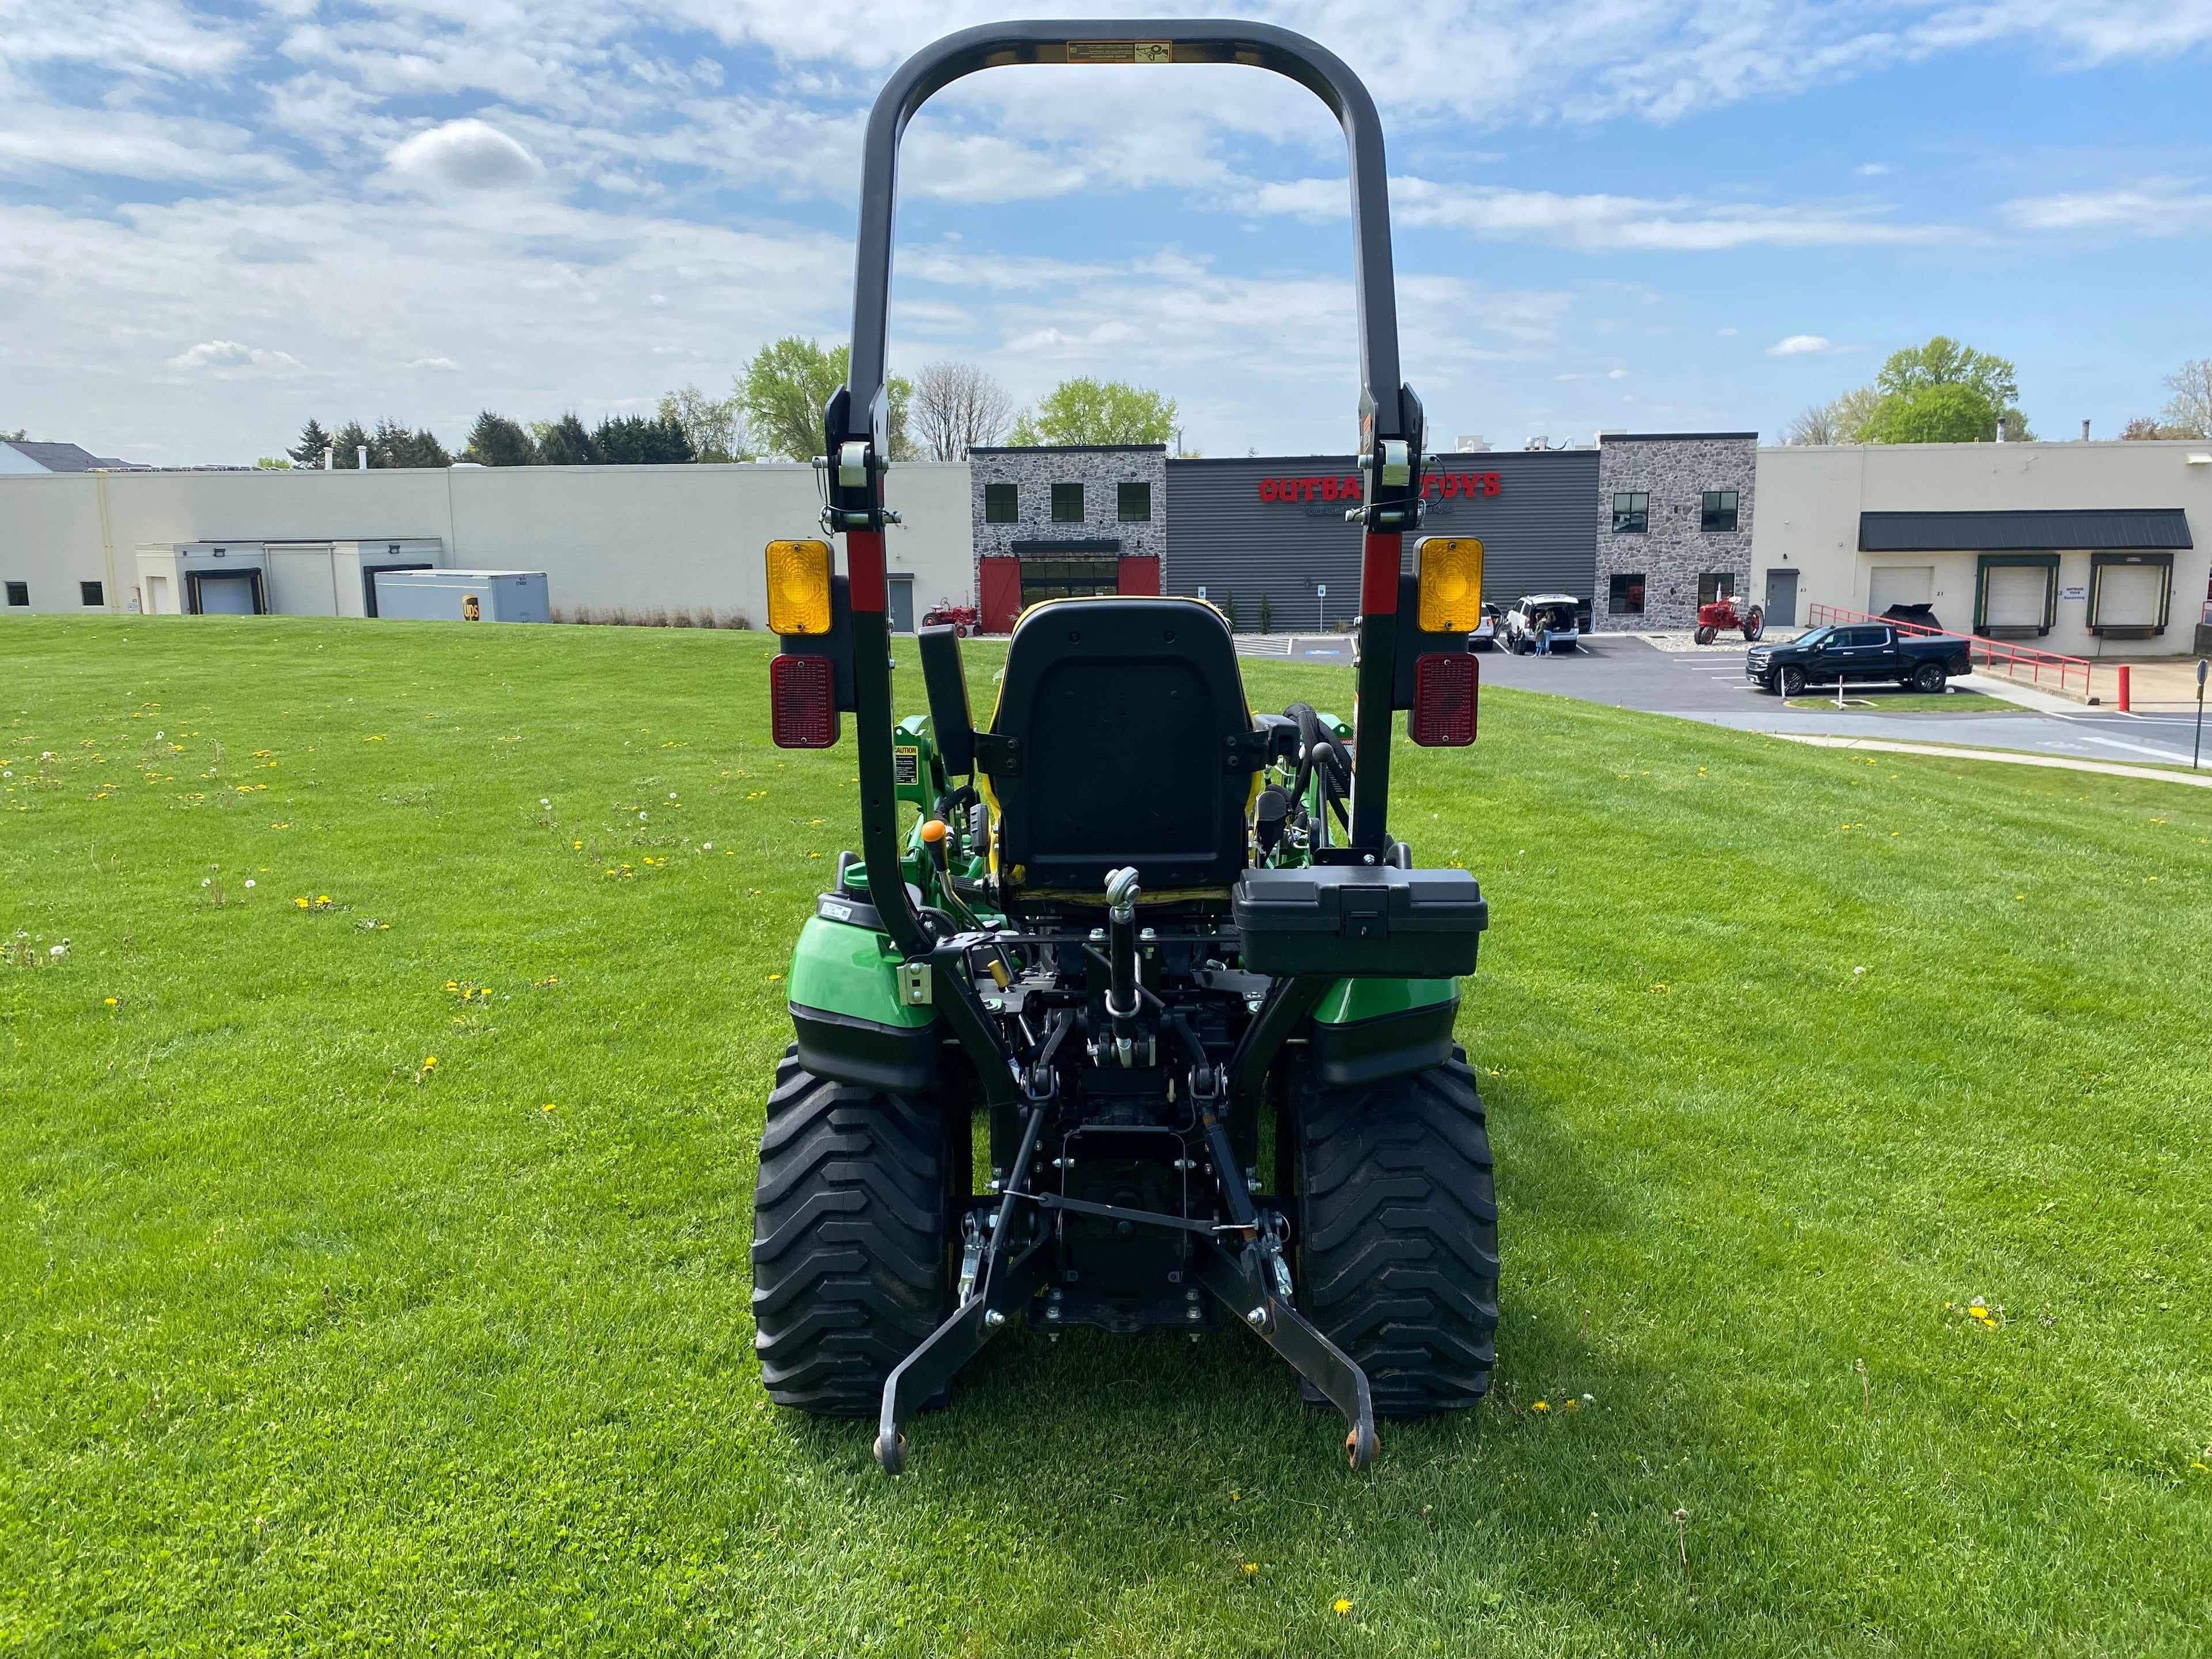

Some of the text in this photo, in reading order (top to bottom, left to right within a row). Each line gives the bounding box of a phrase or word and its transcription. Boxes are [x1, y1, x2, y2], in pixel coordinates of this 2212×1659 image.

[1258, 472, 1501, 502] OUTBA TOYS
[1301, 506, 1324, 514] Your
